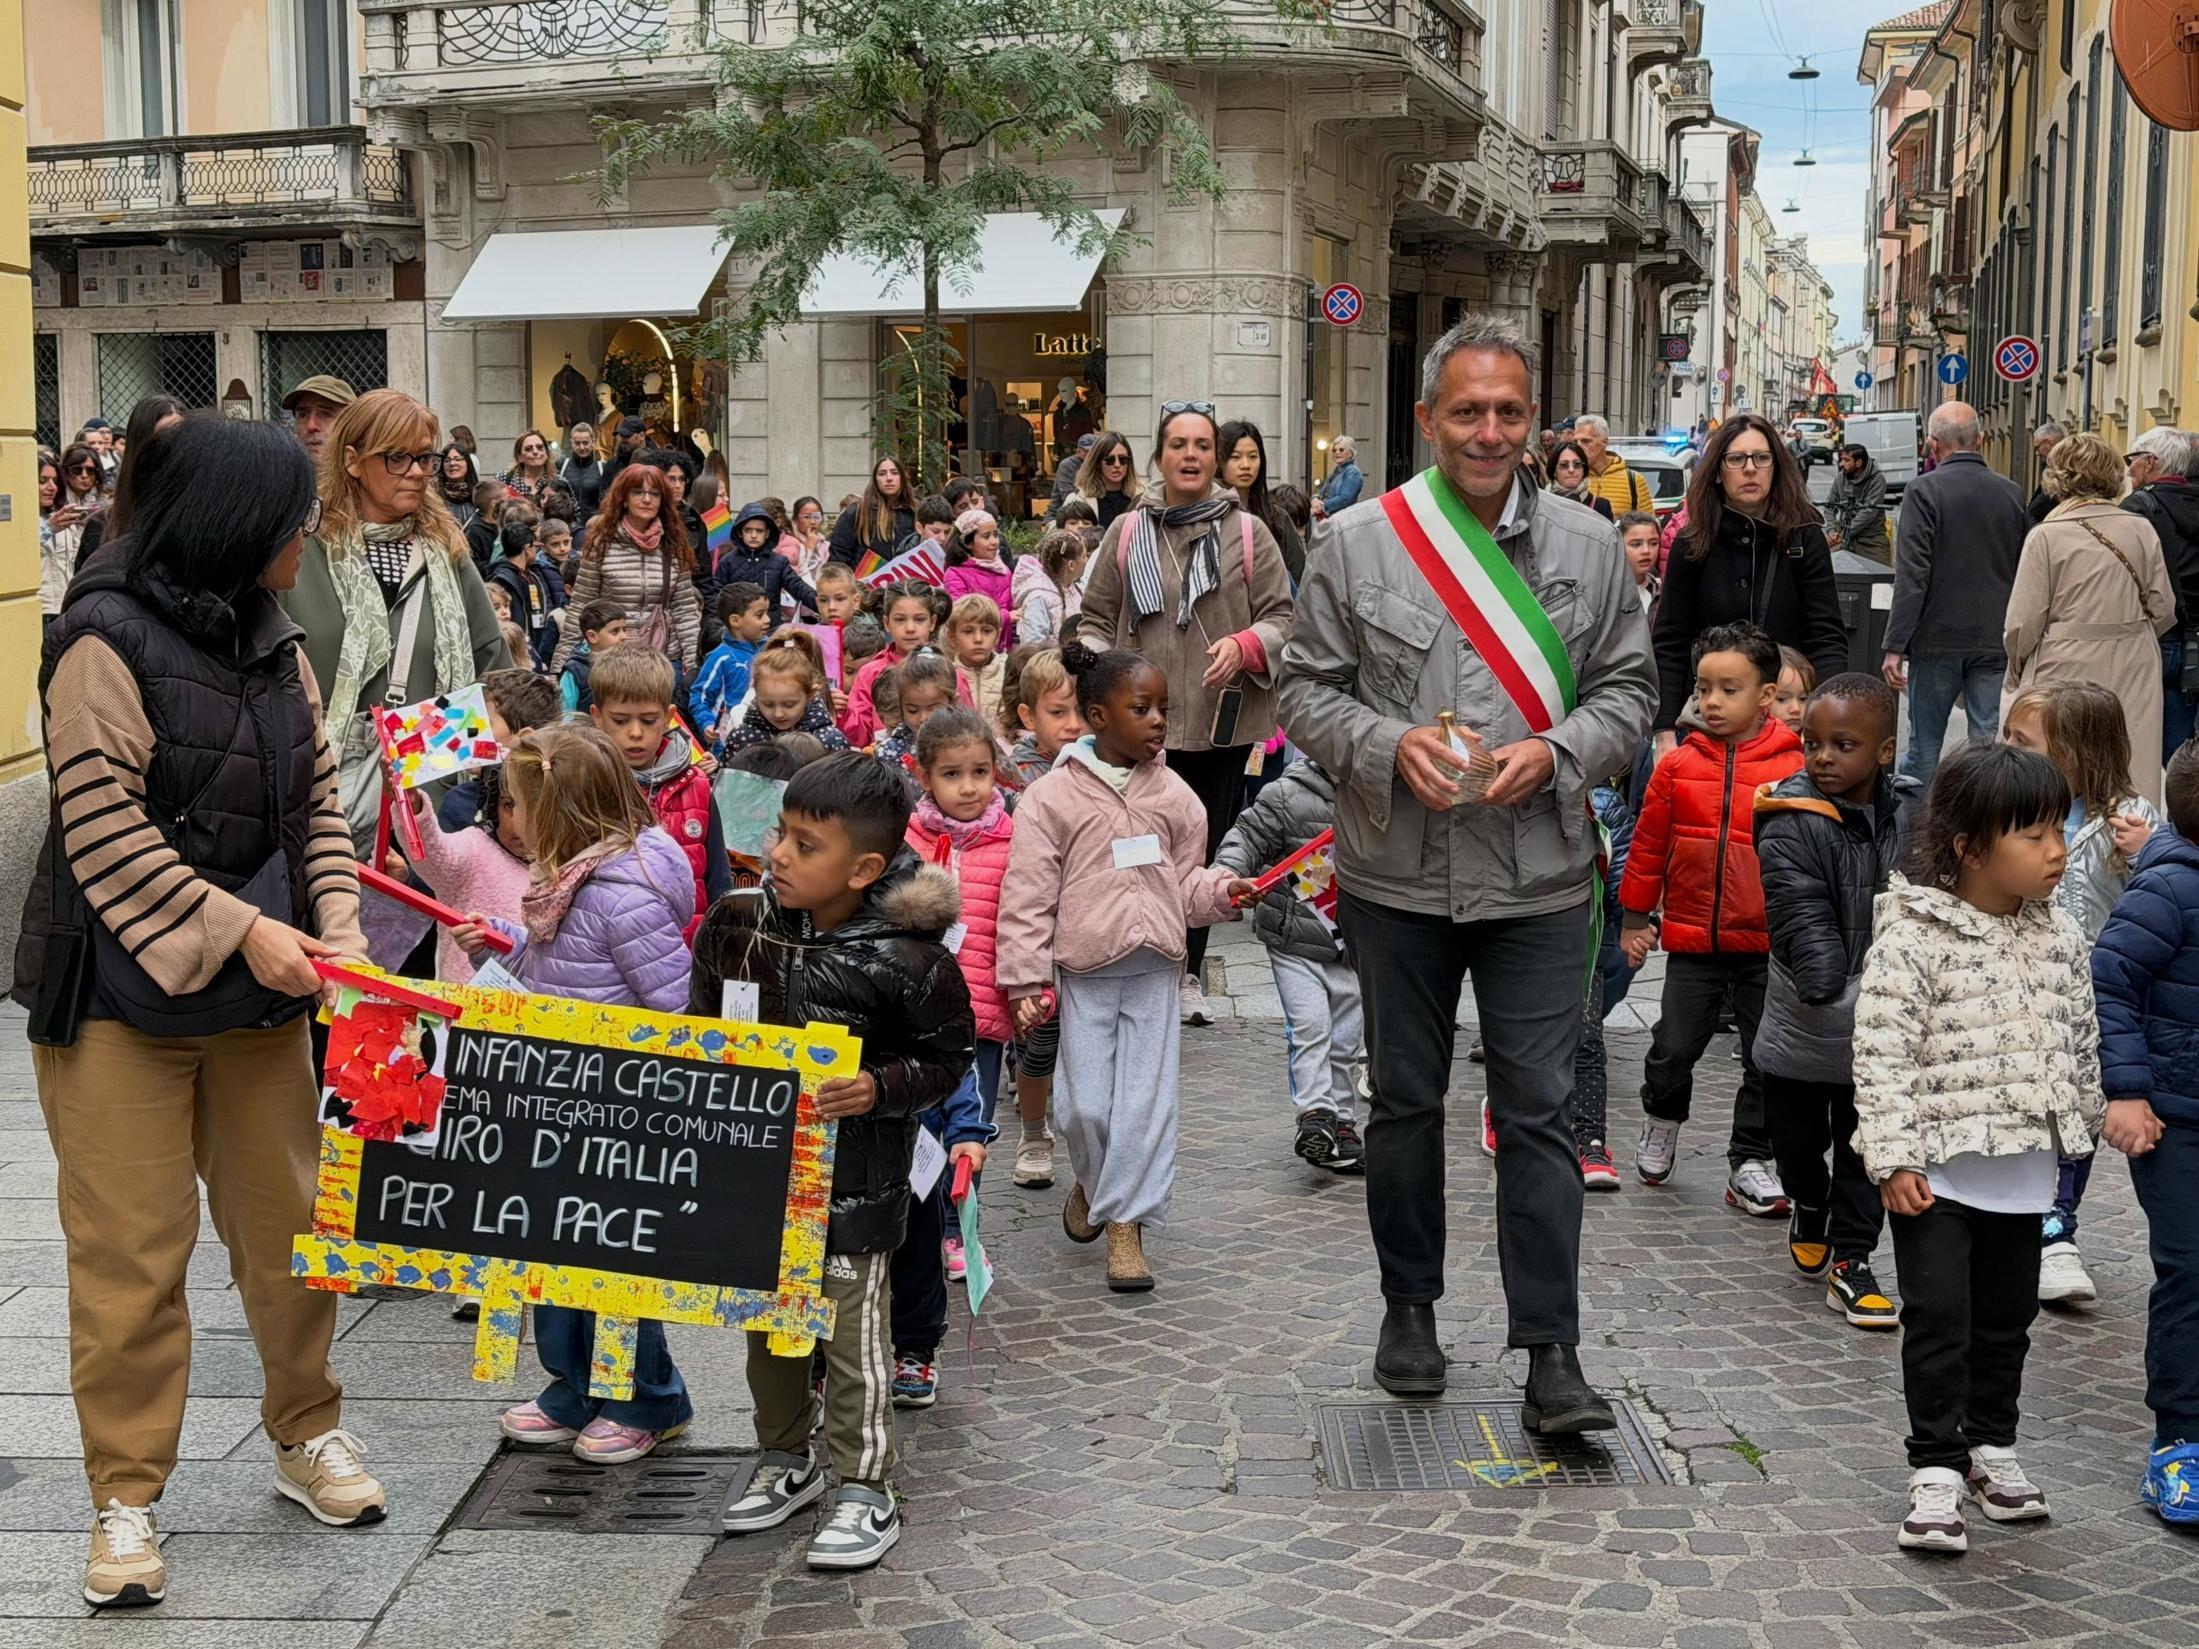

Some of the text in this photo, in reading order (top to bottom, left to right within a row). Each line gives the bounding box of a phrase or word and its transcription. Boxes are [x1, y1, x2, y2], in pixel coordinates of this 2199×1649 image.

[454, 1033, 794, 1118] INFANZIA CASTELLO
[442, 1084, 784, 1149] EMA INTEGRATO COMUNALE
[530, 1128, 698, 1188] D'ITALIA
[378, 1175, 454, 1230] PER
[472, 1190, 531, 1239] LA
[552, 1196, 664, 1254] PACE
